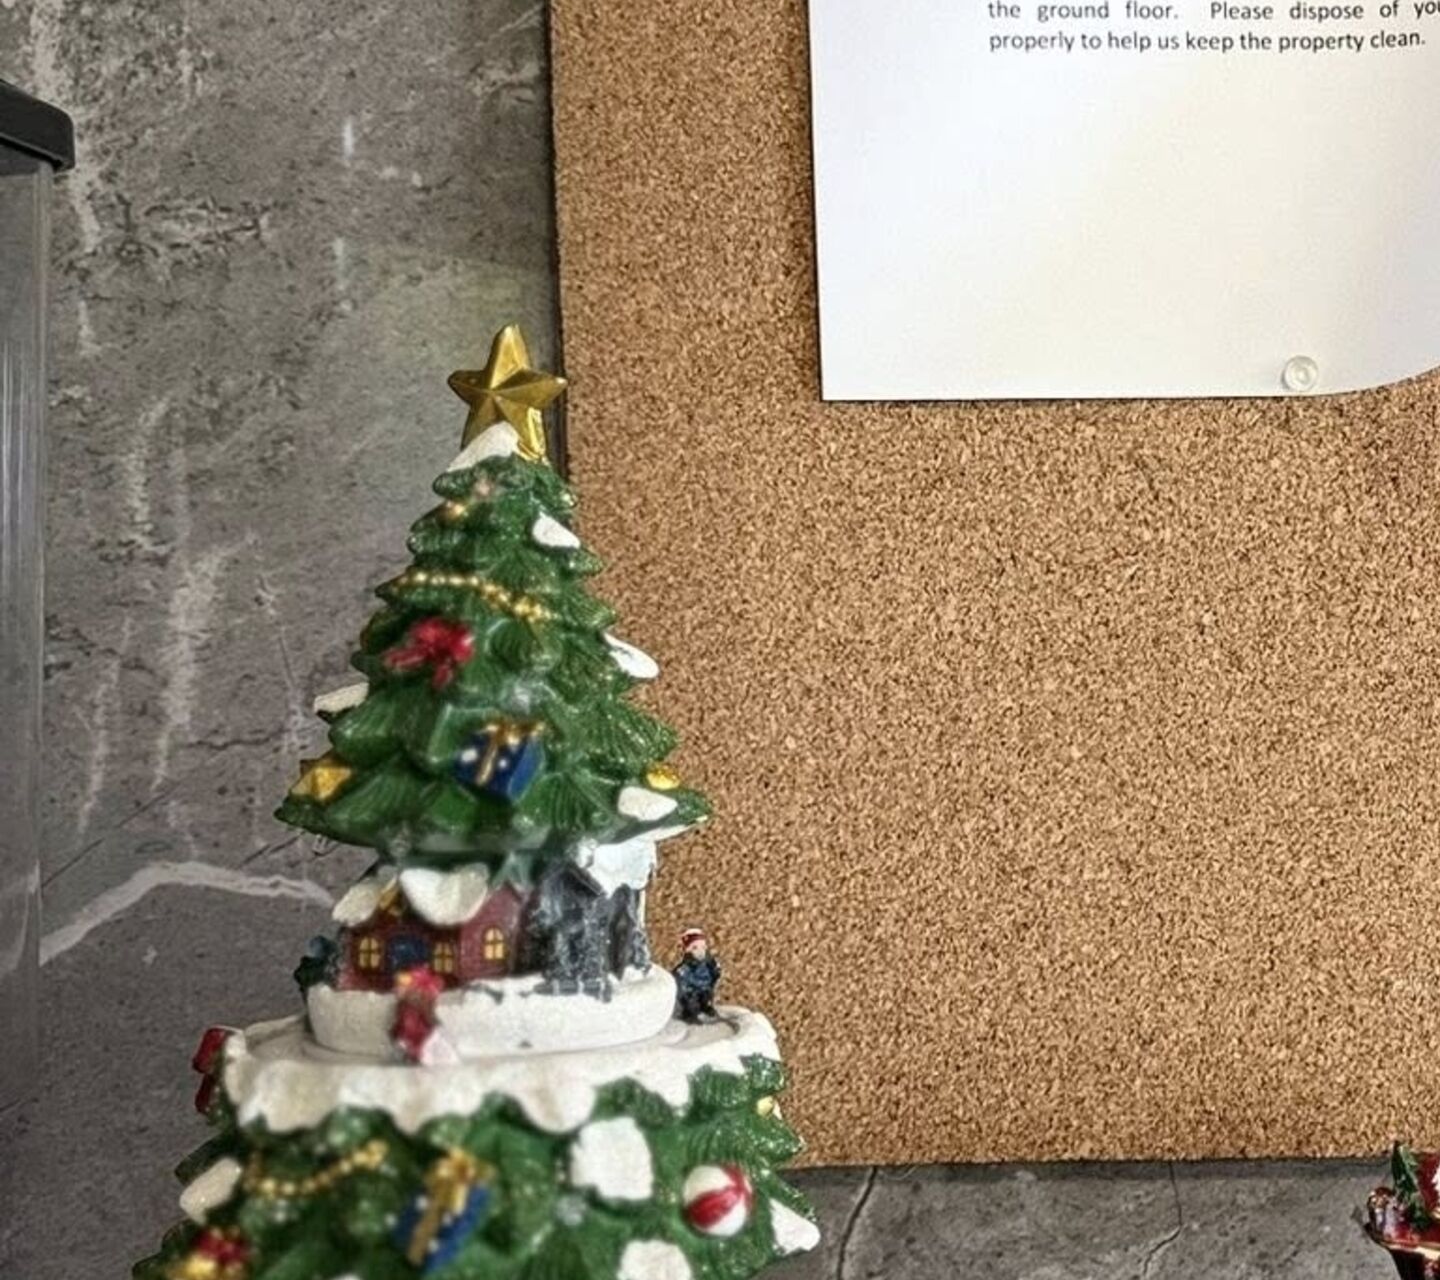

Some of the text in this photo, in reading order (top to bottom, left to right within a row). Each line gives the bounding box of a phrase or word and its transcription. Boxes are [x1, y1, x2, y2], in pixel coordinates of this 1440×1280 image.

[989, 29, 1426, 54] properly to help us keep the property clean.
